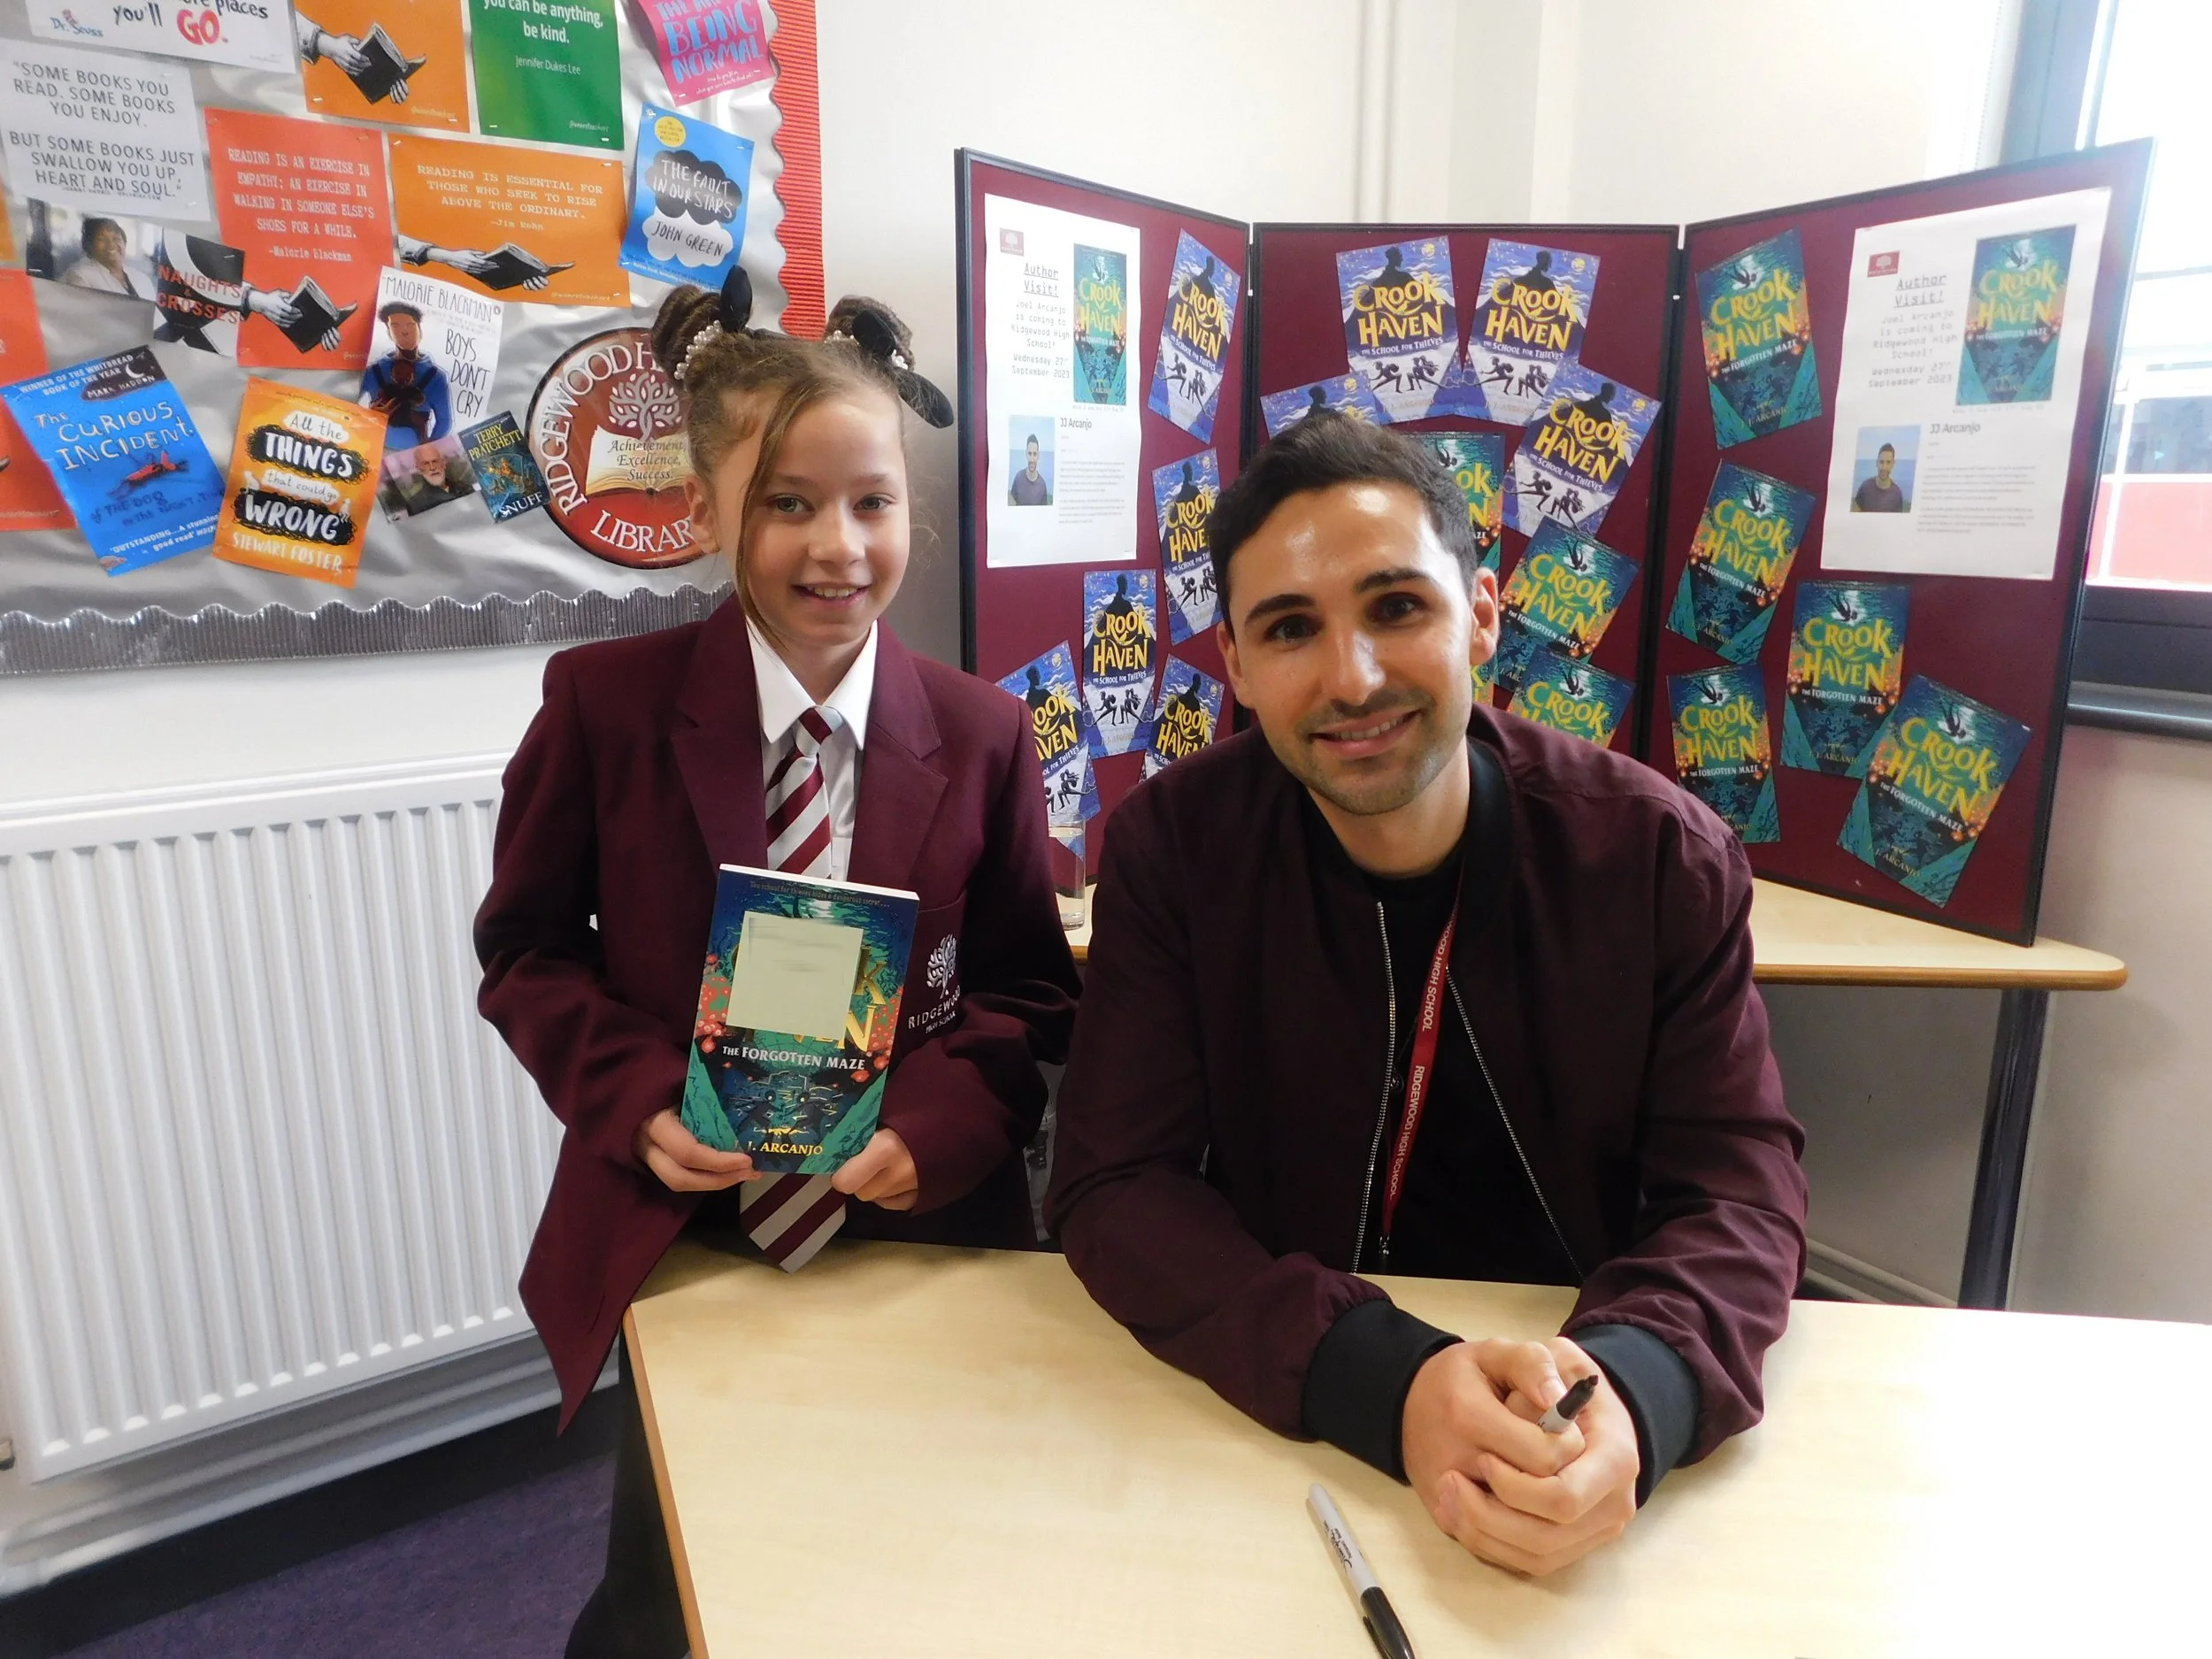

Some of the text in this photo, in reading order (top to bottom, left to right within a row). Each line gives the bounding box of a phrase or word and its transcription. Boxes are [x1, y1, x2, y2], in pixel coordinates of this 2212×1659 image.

[113, 2, 162, 27] you'll
[550, 5, 603, 28] anything,
[663, 0, 757, 56] BEING
[523, 21, 570, 43] be kind.
[516, 56, 580, 74] Jennifer Dukes Lee
[672, 35, 763, 83] NORMAL
[13, 79, 175, 114] READ. SOME BOOKS
[76, 70, 169, 96] BOOKS YOU
[50, 101, 148, 127] YOU ENJOY.
[9, 132, 195, 165] BUT SOME BOOKS JUST
[228, 149, 354, 174] READING IS EXERCISE
[31, 152, 150, 177] SWALLOW YOU
[35, 169, 125, 191] HEART AND
[418, 165, 603, 195] READING IS ESSENTIAL FOR
[661, 159, 730, 196] THE FAULT
[237, 172, 350, 195] EMPATHY; EXERCISE
[427, 180, 597, 206] THOSE WHO SEEK TO RISE
[653, 177, 733, 219] IN OUR STARS
[233, 194, 374, 219] WALKING SOMEONE ELSE'S
[442, 196, 586, 219] ABOVE THE ORDINARY.
[257, 219, 357, 238] SHOES FOR A WHILE.
[651, 221, 723, 257] JOHN GREEN
[314, 249, 351, 261] Blackman
[157, 265, 241, 299] NAUGHTS
[1024, 263, 1059, 279] Author
[1895, 274, 1947, 289] Author
[1979, 258, 2059, 300] CROOK
[386, 276, 434, 306] MALORIE
[439, 288, 492, 324] BLACKMAN
[1024, 280, 1058, 296] Visit!
[1079, 278, 1122, 308] CROOK
[1352, 271, 1446, 316] CROOK
[1491, 278, 1578, 323] CROOK
[1710, 268, 1797, 326] CROOK
[1893, 292, 1945, 307] Visit!
[156, 292, 238, 324] CROSSES
[1029, 315, 1054, 326] coming
[1038, 303, 1066, 315] Arcanjo
[1079, 303, 1121, 334] HAVEN
[1179, 273, 1225, 337] CROOK
[1912, 311, 1954, 321] Arcanjo
[1978, 294, 2053, 330] HAVEN
[1010, 324, 1050, 337] Ridgewood
[1172, 302, 1222, 363] HAVEN
[1358, 304, 1443, 348] HAVEN
[1485, 306, 1572, 352] HAVEN
[1717, 303, 1796, 361] HAVEN
[446, 328, 476, 362] BOYS
[1371, 337, 1444, 355] SCHOOL THIEVES
[1873, 338, 1926, 349] Ridgewood
[20, 355, 134, 393] WINNER OF THE WHITBREAD
[451, 359, 491, 390] DON'T
[1012, 366, 1048, 377] September
[1013, 355, 1051, 365] Wednesday
[1872, 365, 1925, 377] Wednesday
[70, 367, 122, 388] OF YEAR
[119, 375, 155, 389] HADDON
[1869, 377, 1921, 388] September
[457, 390, 482, 418] CRY
[35, 412, 68, 428] The
[290, 414, 342, 440] All the
[474, 424, 504, 443] TERRY
[541, 343, 633, 516] RIDGEWOOD
[1069, 419, 1092, 431] Arcanjo
[1550, 397, 1629, 459] CROOK
[1942, 422, 1981, 436] Arcanjo
[265, 432, 353, 478] THINGS
[468, 430, 521, 460] PRATCHETT
[608, 440, 687, 453] Achievement,
[617, 454, 681, 466] Excellence,
[1533, 425, 1619, 483] HAVEN
[267, 471, 326, 495] that could
[627, 469, 673, 481] Success.
[245, 494, 340, 541] WRONG
[499, 492, 542, 517] SNUFF
[591, 509, 695, 552] LIBRAR
[1714, 499, 1791, 558] CROOK
[234, 532, 342, 572] STEWART FOSTER
[1704, 529, 1779, 588] HAVEN
[1531, 554, 1611, 616] CROOK
[1093, 603, 1150, 645] CROOK
[1515, 580, 1596, 640] HAVEN
[1517, 613, 1580, 649] FORGOTTEN MAZE
[1803, 618, 1893, 658] CROOK
[1093, 638, 1148, 676] HAVEN
[1802, 649, 1887, 693] HAVEN
[1127, 671, 1147, 682] THIEVES
[1164, 695, 1211, 742] CROOK
[1528, 681, 1610, 738] CROOK
[1682, 695, 1759, 737] CROOK
[1686, 729, 1759, 767] HAVEN
[1902, 718, 1996, 793] CROOK
[1886, 749, 1979, 822] HAVEN
[1889, 786, 1937, 818] FORGOTTEN
[1423, 956, 1442, 1032] HIGH SCHOOL
[722, 1046, 865, 1071] THE FORGOTTEN MAZE
[1389, 1065, 1425, 1201] RIDGEWOOD HIGH SCHOOL
[761, 1142, 823, 1156] ARCANJO
